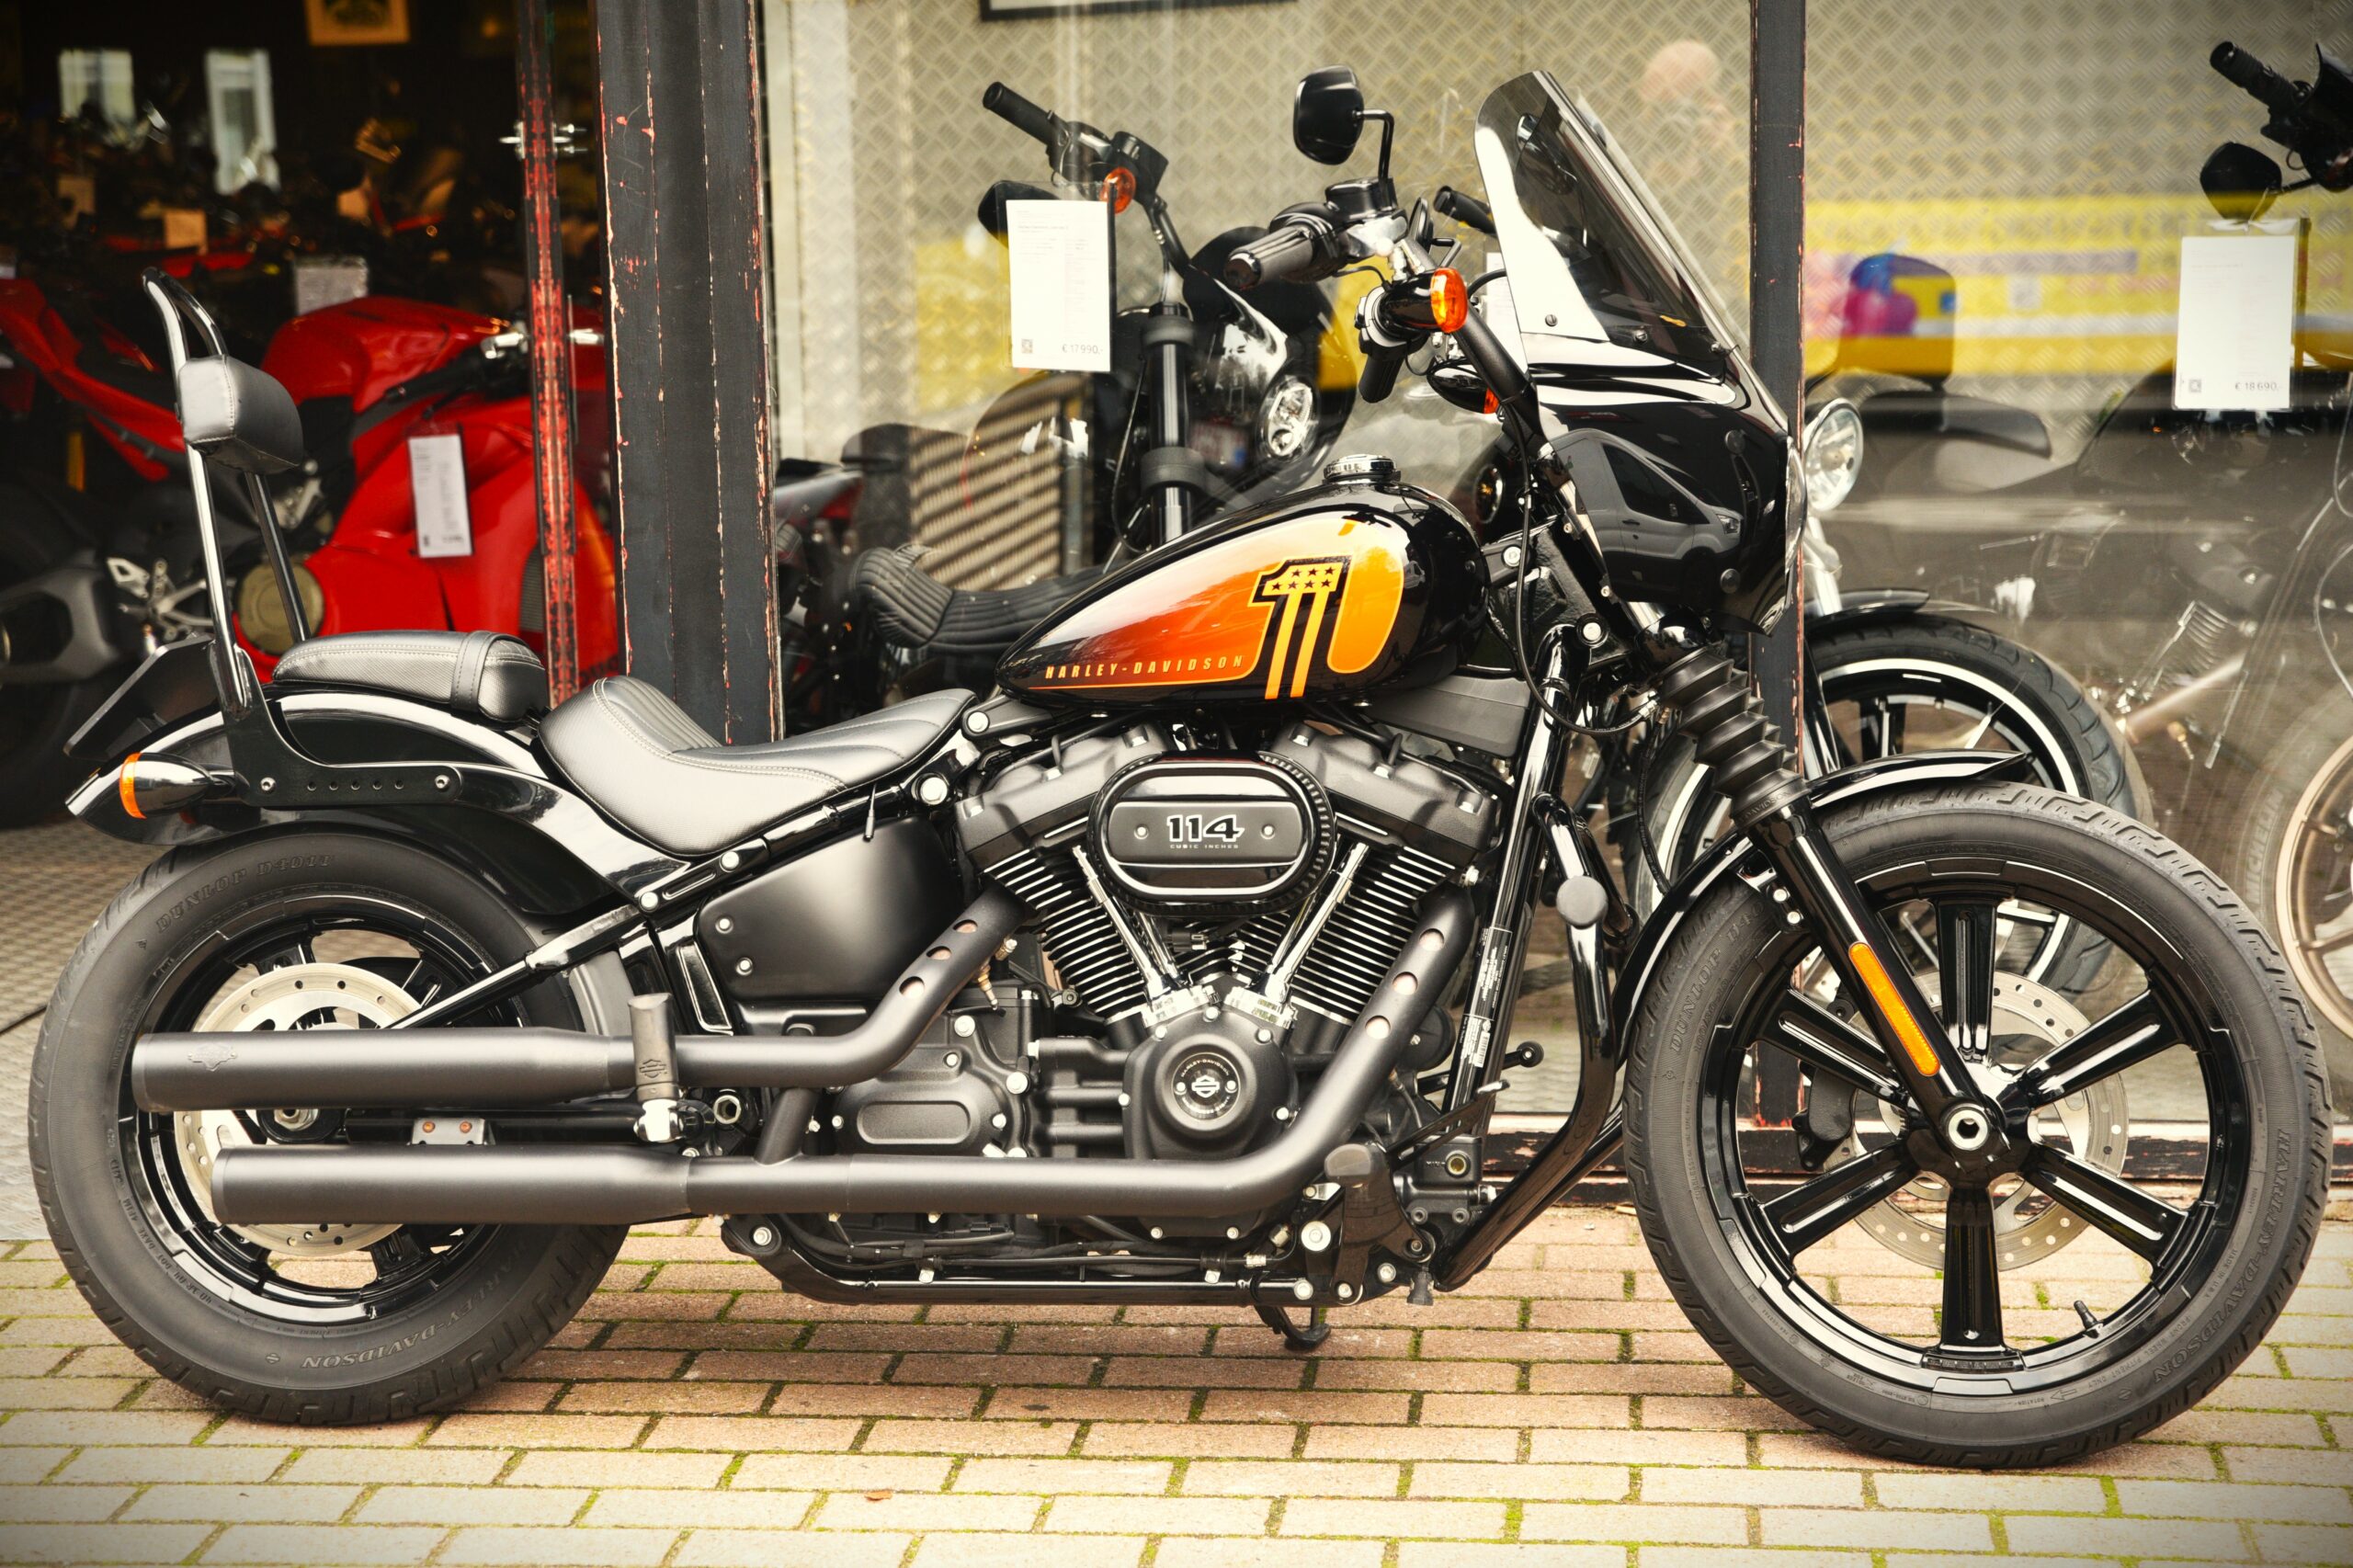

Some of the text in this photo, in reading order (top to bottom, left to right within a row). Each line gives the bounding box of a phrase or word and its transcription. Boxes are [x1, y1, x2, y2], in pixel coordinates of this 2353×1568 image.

[1045, 654, 1245, 679] HARLEY-DAVIDSON
[1166, 814, 1245, 842] 114
[155, 868, 248, 934] DUNLOP
[1669, 948, 1721, 1055] DUNLOP
[2153, 1128, 2291, 1382] HARLEY-DAVIDSON
